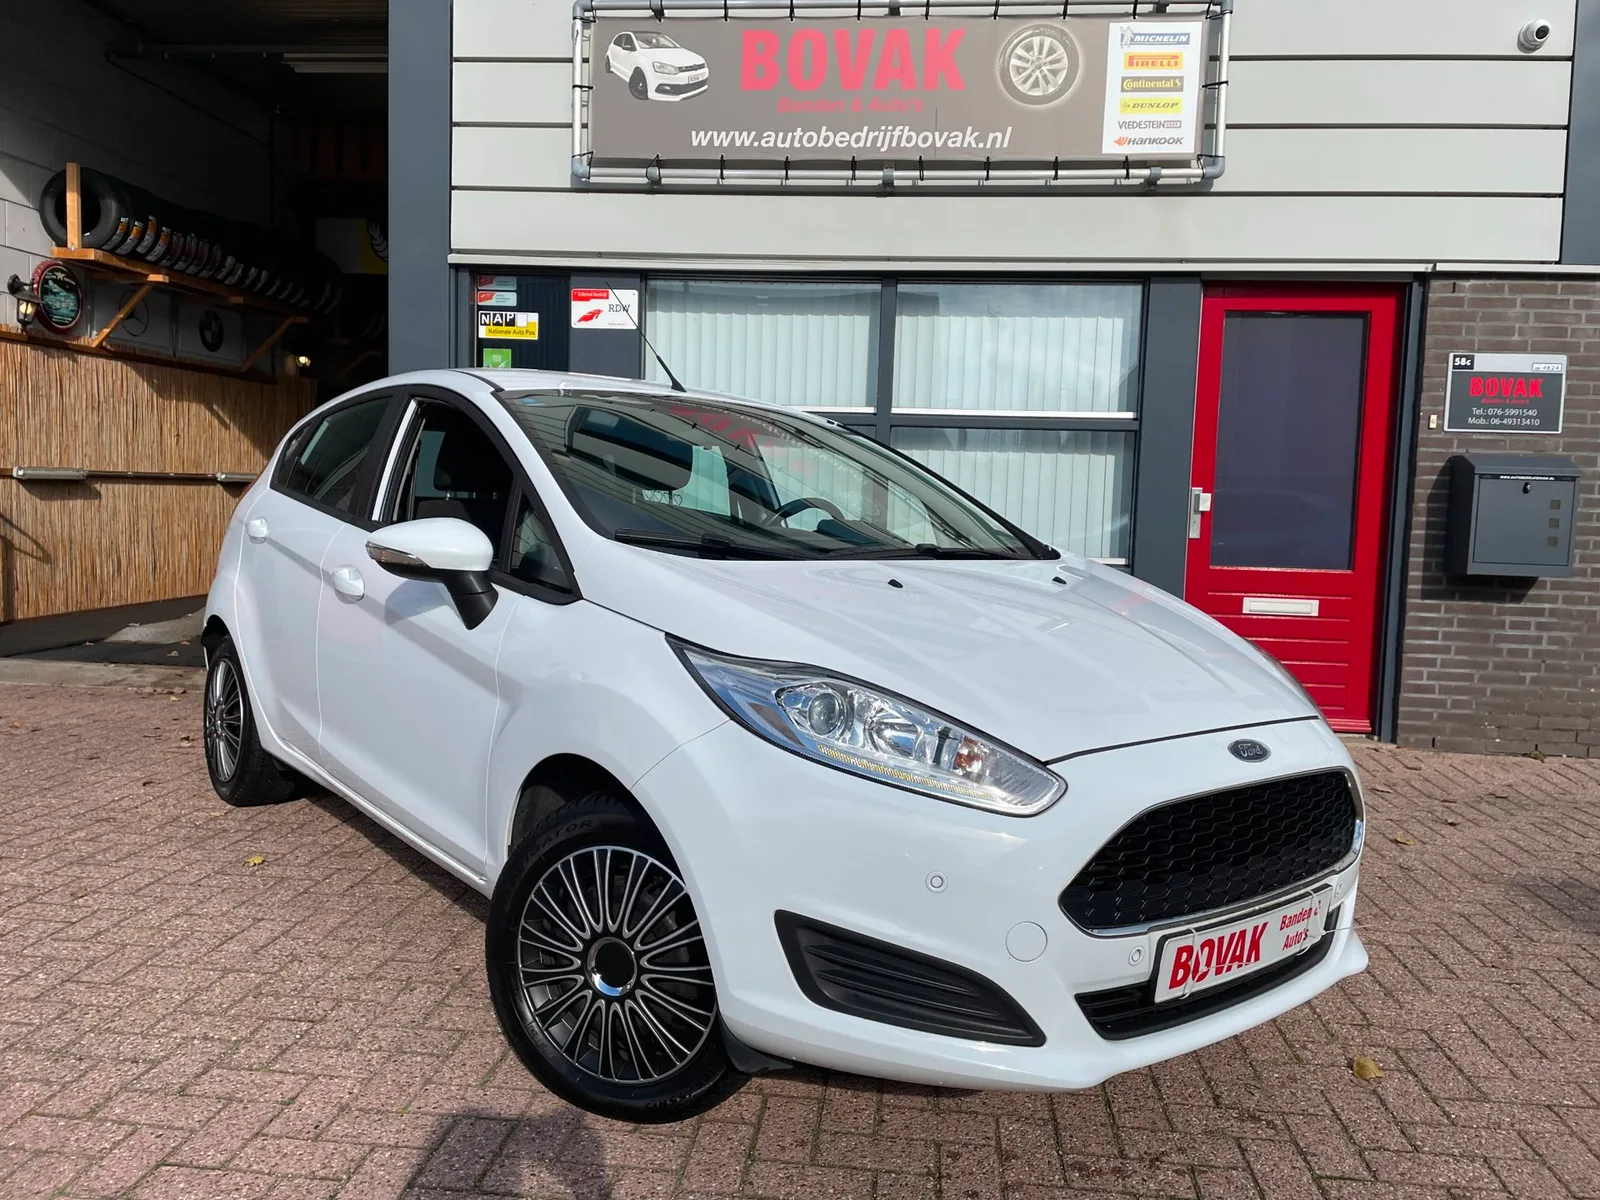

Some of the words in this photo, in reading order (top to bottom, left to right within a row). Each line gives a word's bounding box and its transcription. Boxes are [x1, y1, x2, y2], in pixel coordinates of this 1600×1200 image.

[741, 28, 967, 91] BOVAK
[1128, 55, 1179, 67] PIRELLI
[1123, 78, 1174, 90] Continental
[1118, 120, 1165, 129] VREDESTEIN
[690, 126, 1013, 152] www.autobedrijfbovak.nl
[608, 304, 630, 312] RDW
[481, 313, 515, 324] NAP
[1454, 357, 1471, 366] 58c
[1469, 376, 1544, 398] BOVAK
[1487, 408, 1538, 416] 076-5991540
[1490, 417, 1540, 426] 06-49313410
[1238, 743, 1263, 757] Ford
[1279, 907, 1313, 931] Banden
[1282, 927, 1310, 951] Auto's
[1168, 921, 1269, 990] BOVAK
